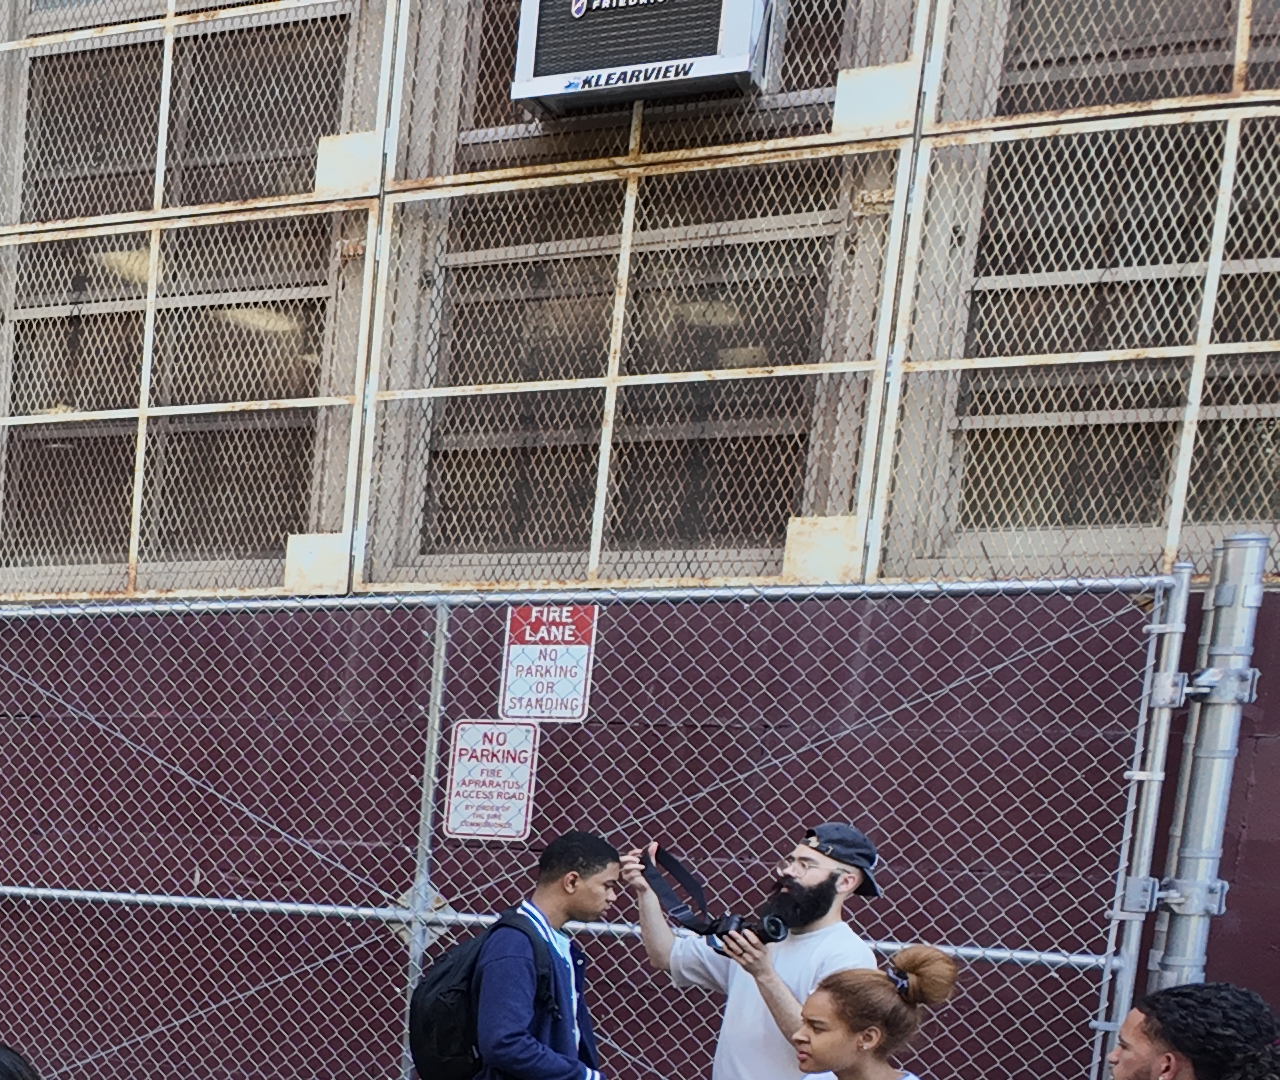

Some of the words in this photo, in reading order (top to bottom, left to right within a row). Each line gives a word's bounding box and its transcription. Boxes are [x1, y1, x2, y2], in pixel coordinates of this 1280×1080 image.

[580, 61, 695, 90] KLEARVIEW
[531, 606, 574, 622] FIRE
[525, 625, 576, 641] LANE
[538, 648, 558, 661] NO
[515, 664, 578, 678] PARKING
[535, 681, 555, 694] OR
[508, 696, 579, 711] STANDING
[482, 731, 508, 746] NO
[458, 747, 529, 764] PARKING
[480, 768, 503, 778] FIRE
[460, 779, 521, 790] APPARATUS
[454, 790, 494, 800] ACCESS
[496, 791, 525, 801] ROAD
